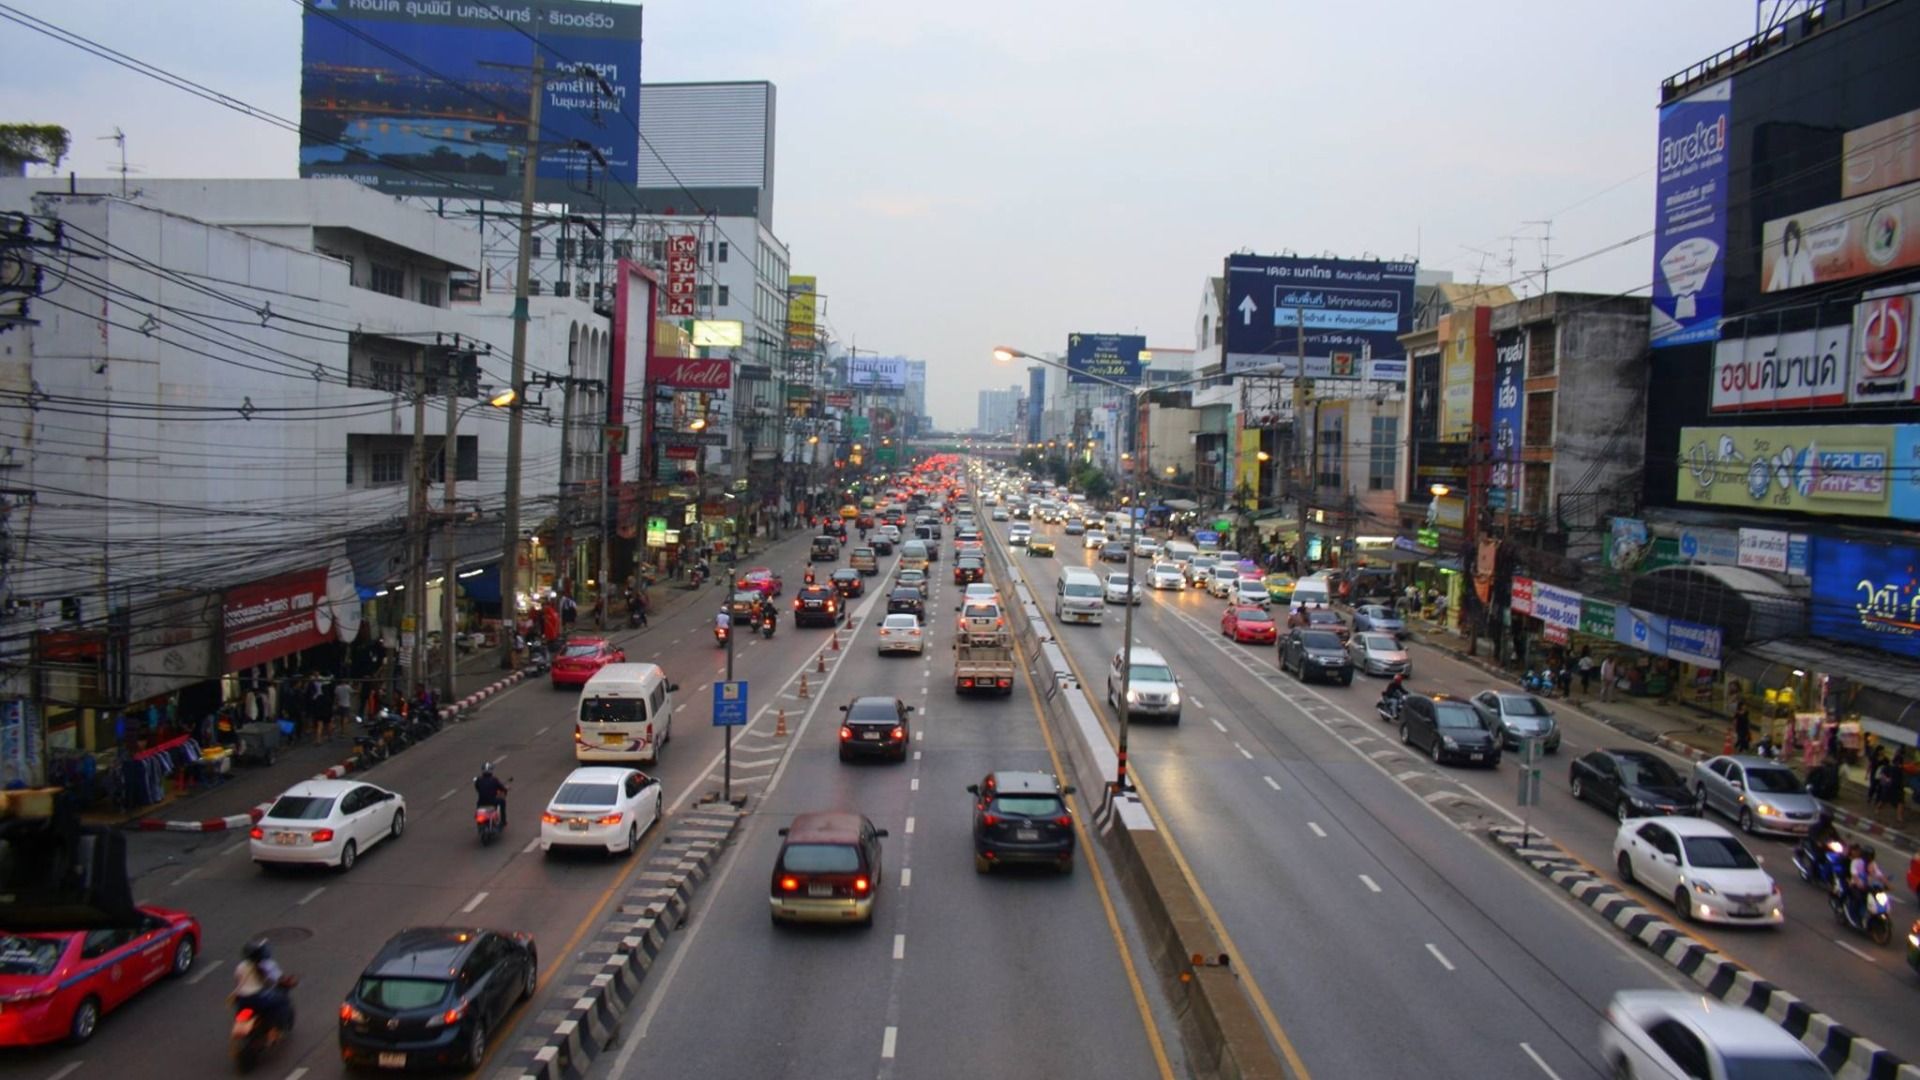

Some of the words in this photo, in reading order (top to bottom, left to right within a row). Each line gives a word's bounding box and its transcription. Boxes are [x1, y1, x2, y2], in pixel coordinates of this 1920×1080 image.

[549, 11, 614, 29] ริเวอร์วิว
[1660, 114, 1725, 173] Eureka!
[668, 362, 727, 384] Noelle
[1720, 341, 1837, 392] ออนดีมานด์
[1820, 476, 1882, 493] PHYSICS
